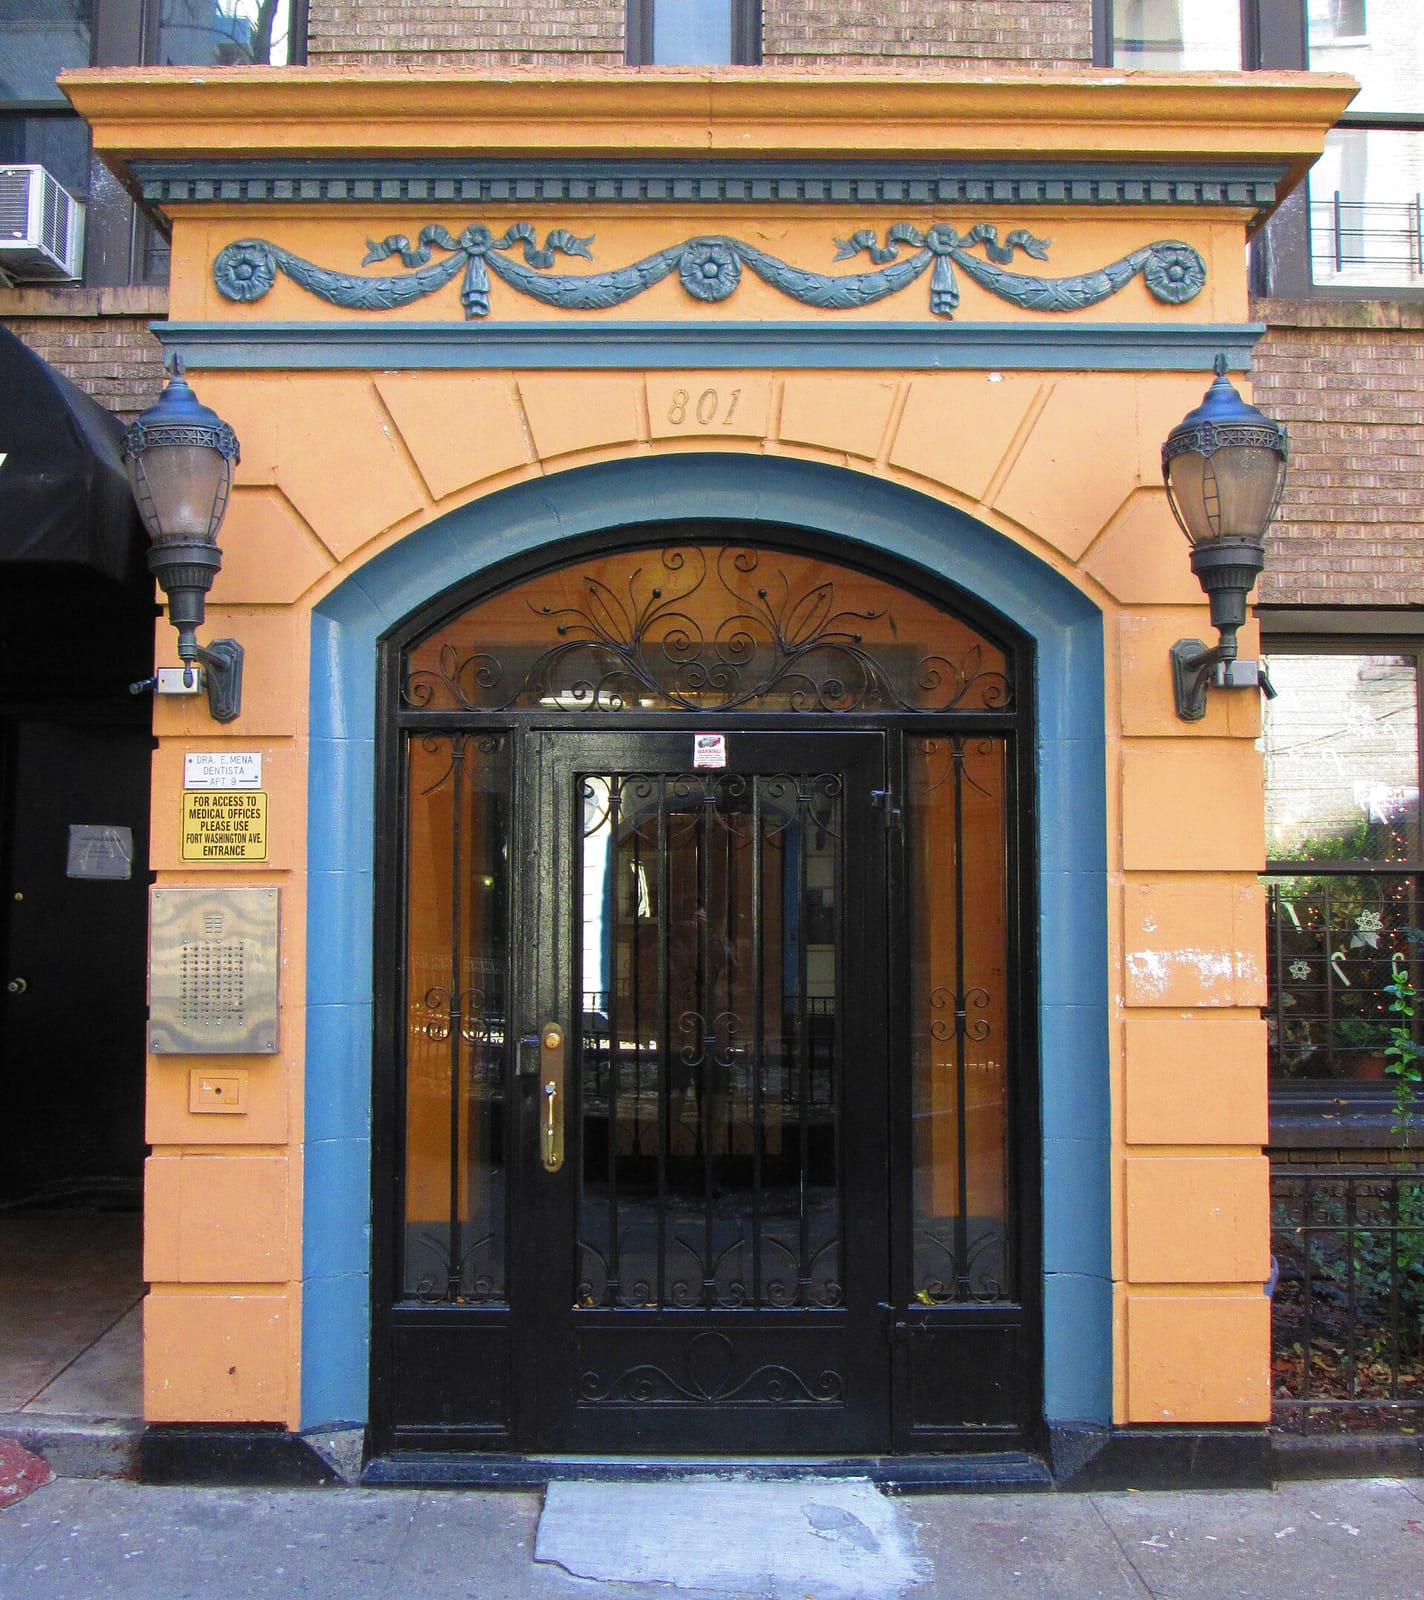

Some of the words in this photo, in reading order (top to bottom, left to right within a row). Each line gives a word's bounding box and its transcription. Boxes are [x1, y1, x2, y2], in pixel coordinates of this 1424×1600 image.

[667, 388, 741, 425] 801
[203, 766, 245, 775] DENTISTA
[209, 777, 226, 785] APT
[231, 777, 237, 786] 9
[194, 796, 209, 807] FOR
[213, 796, 244, 807] ACCESS
[246, 796, 257, 807] TO
[189, 808, 225, 819] MEDICAL
[228, 808, 261, 819] OFFICES
[200, 821, 231, 831] PLEASE
[233, 821, 249, 831] USE
[186, 833, 203, 844] FORT
[204, 833, 247, 844] WASHINGTON
[248, 833, 263, 844] AVE.
[203, 845, 246, 856] ENTRANCE
